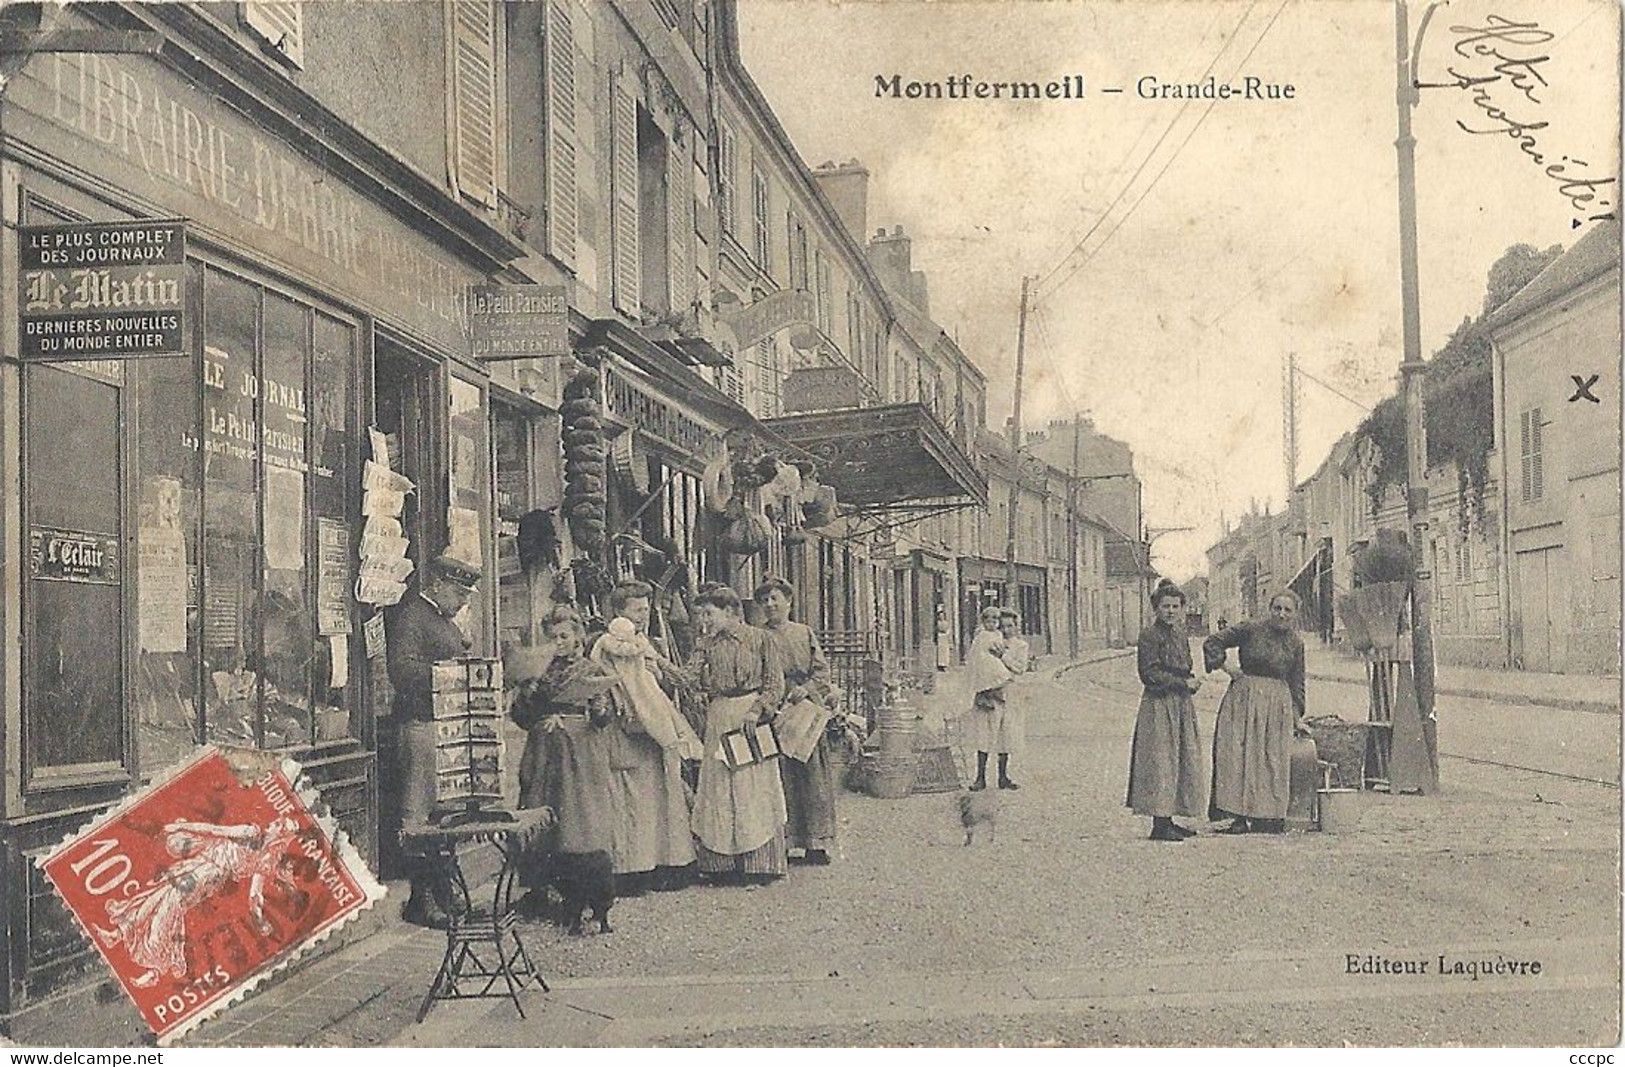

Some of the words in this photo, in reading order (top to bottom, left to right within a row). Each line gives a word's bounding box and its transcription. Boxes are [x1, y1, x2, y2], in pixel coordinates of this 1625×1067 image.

[51, 51, 242, 208] LIBRAIRIE
[31, 235, 50, 248] LE
[55, 231, 93, 247] PLUS
[100, 230, 174, 244] COMPLET
[40, 250, 69, 264] DES
[76, 246, 166, 262] JOURNAUX
[26, 270, 68, 311] Le
[70, 268, 180, 310] Matin
[516, 291, 566, 313] Parisien
[105, 316, 178, 331] NOUVELLES
[40, 338, 60, 351] DU
[63, 336, 111, 350] MONDE
[116, 334, 164, 348] ENTIER
[493, 339, 528, 353] MONDE
[203, 360, 225, 390] LE
[210, 407, 226, 434] Le
[228, 412, 256, 444] Petit
